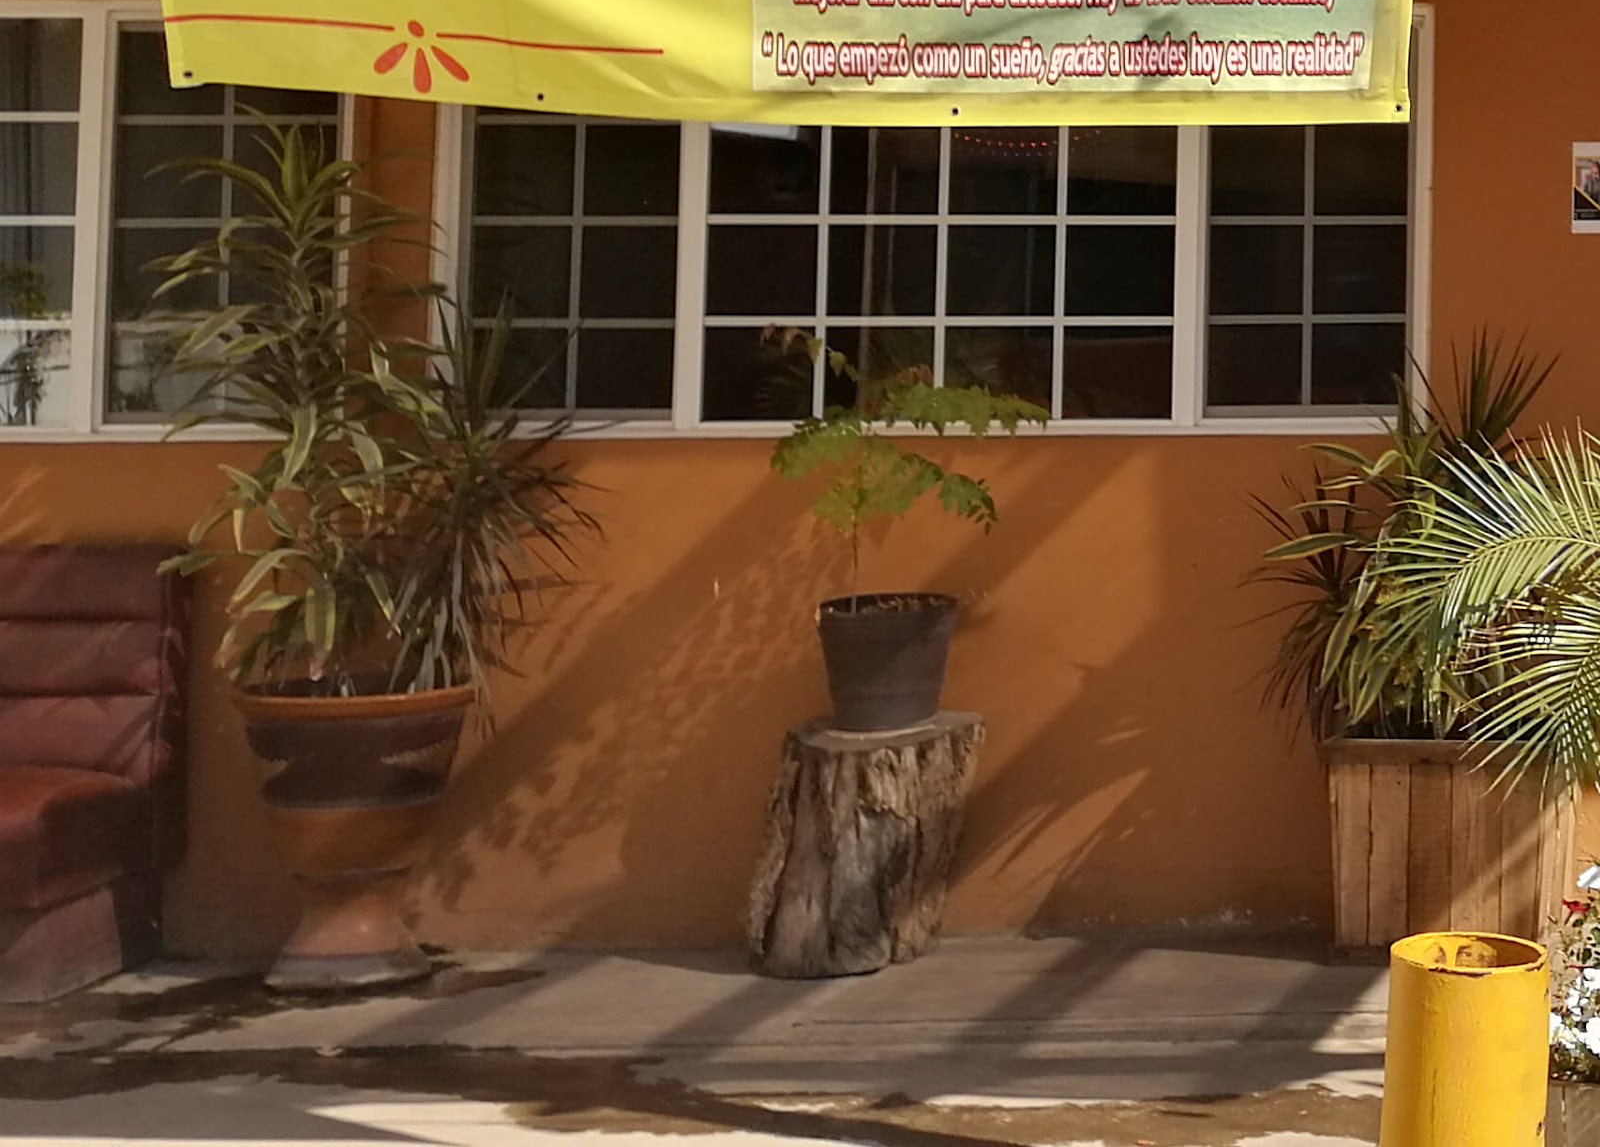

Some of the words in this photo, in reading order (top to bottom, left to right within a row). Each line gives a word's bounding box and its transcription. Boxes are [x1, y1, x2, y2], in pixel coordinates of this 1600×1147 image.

[802, 41, 836, 85] que
[839, 34, 909, 85] empezó
[912, 43, 962, 78] como
[963, 44, 988, 78] un
[990, 36, 1047, 83] sueño,
[1047, 35, 1106, 84] gracias
[1108, 41, 1120, 77] a
[1123, 31, 1188, 77] ustedes
[1190, 31, 1224, 84] hoy
[1226, 41, 1247, 77] es
[1250, 40, 1283, 77] una
